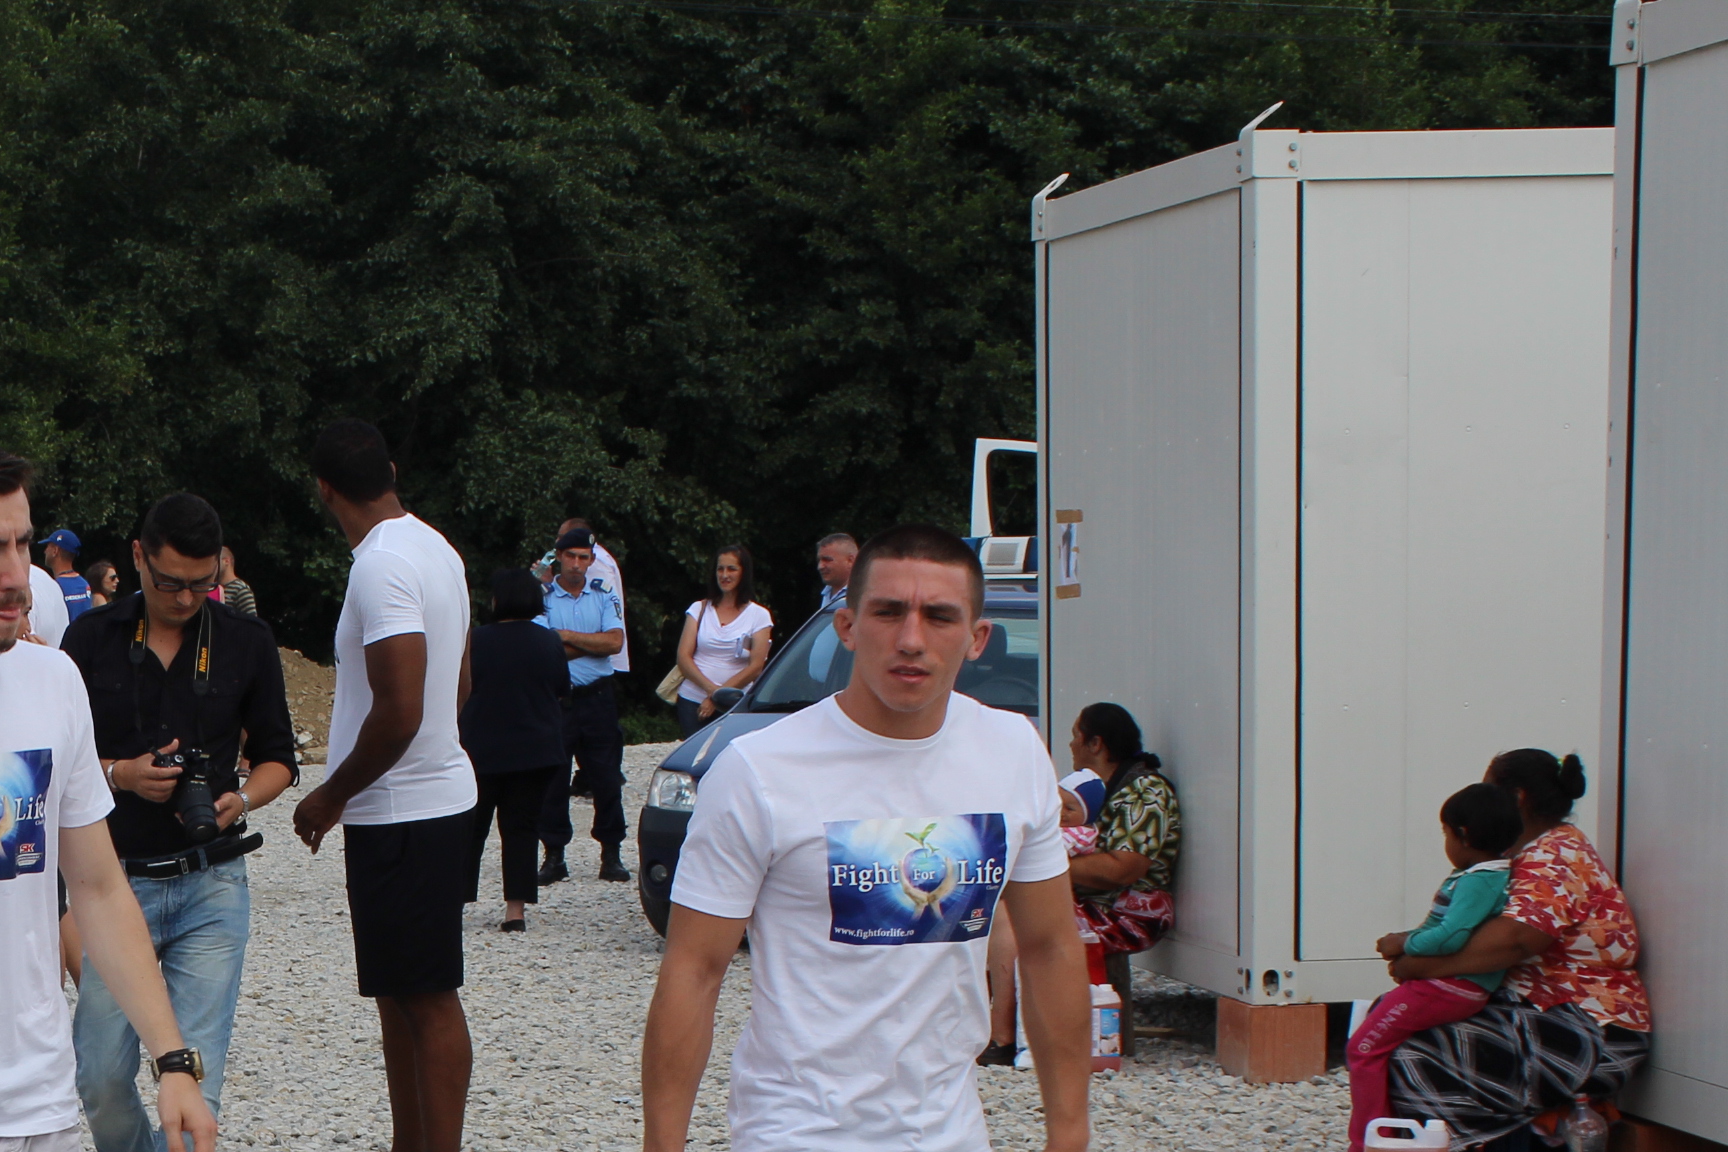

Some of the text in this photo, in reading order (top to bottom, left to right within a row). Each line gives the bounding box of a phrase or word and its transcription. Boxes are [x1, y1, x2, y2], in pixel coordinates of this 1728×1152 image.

[198, 647, 208, 673] Nikon
[14, 794, 44, 822] Life
[831, 857, 1003, 892] Fight For Life
[834, 926, 914, 939] www.fightforlife.ro
